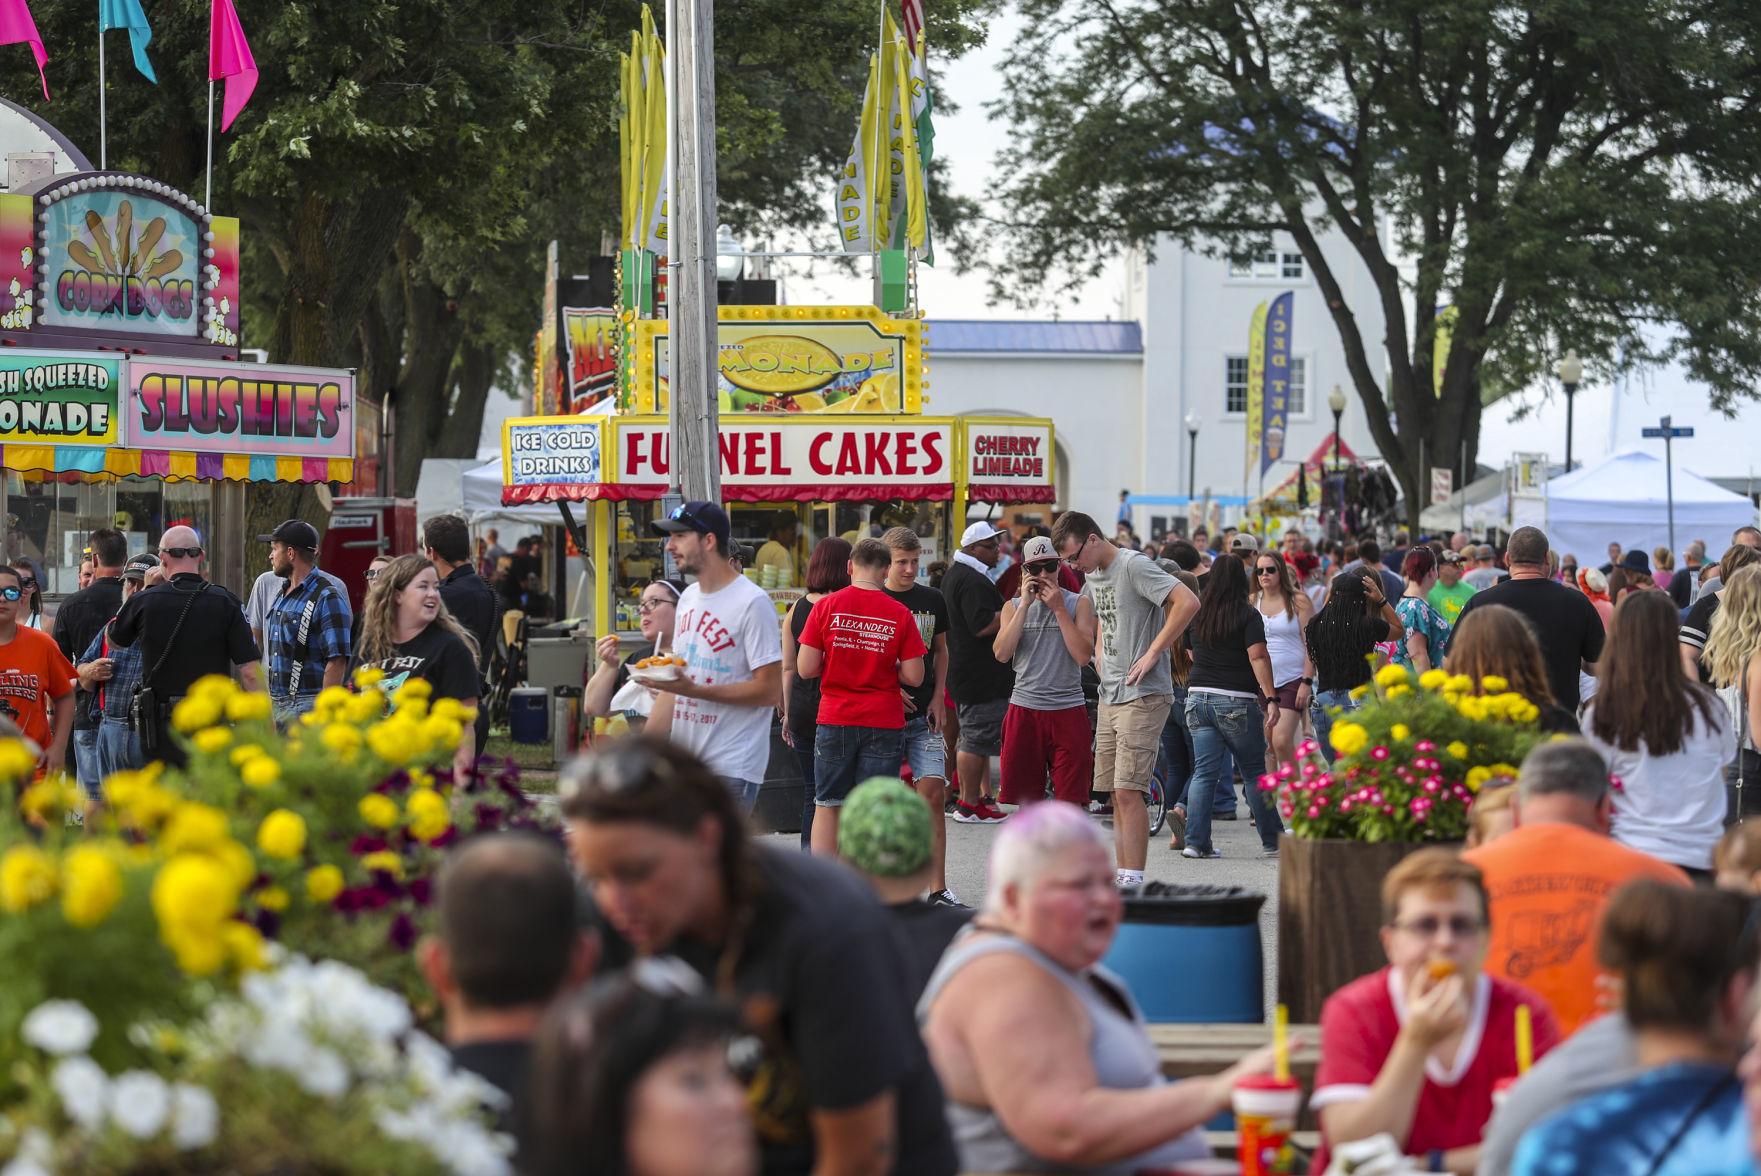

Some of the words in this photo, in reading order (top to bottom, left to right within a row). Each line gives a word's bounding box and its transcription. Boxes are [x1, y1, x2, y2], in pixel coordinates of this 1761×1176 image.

[56, 269, 124, 317] CORN
[127, 275, 194, 321] DOGS
[718, 347, 895, 375] MONADE
[23, 363, 109, 394] SQUEEZED
[140, 373, 341, 438] SLUSHIES
[515, 433, 541, 451] ICE
[547, 432, 595, 450] COLD
[975, 435, 1041, 456] CHERRY
[626, 432, 791, 475] FUNEL
[809, 432, 943, 475] CAKES
[521, 456, 591, 475] DRINKS
[973, 456, 1043, 477] LIMEADE
[696, 611, 736, 652] FEST
[830, 615, 896, 635] ALEXANDER'S
[391, 656, 425, 669] FEST
[700, 713, 717, 724] 2017
